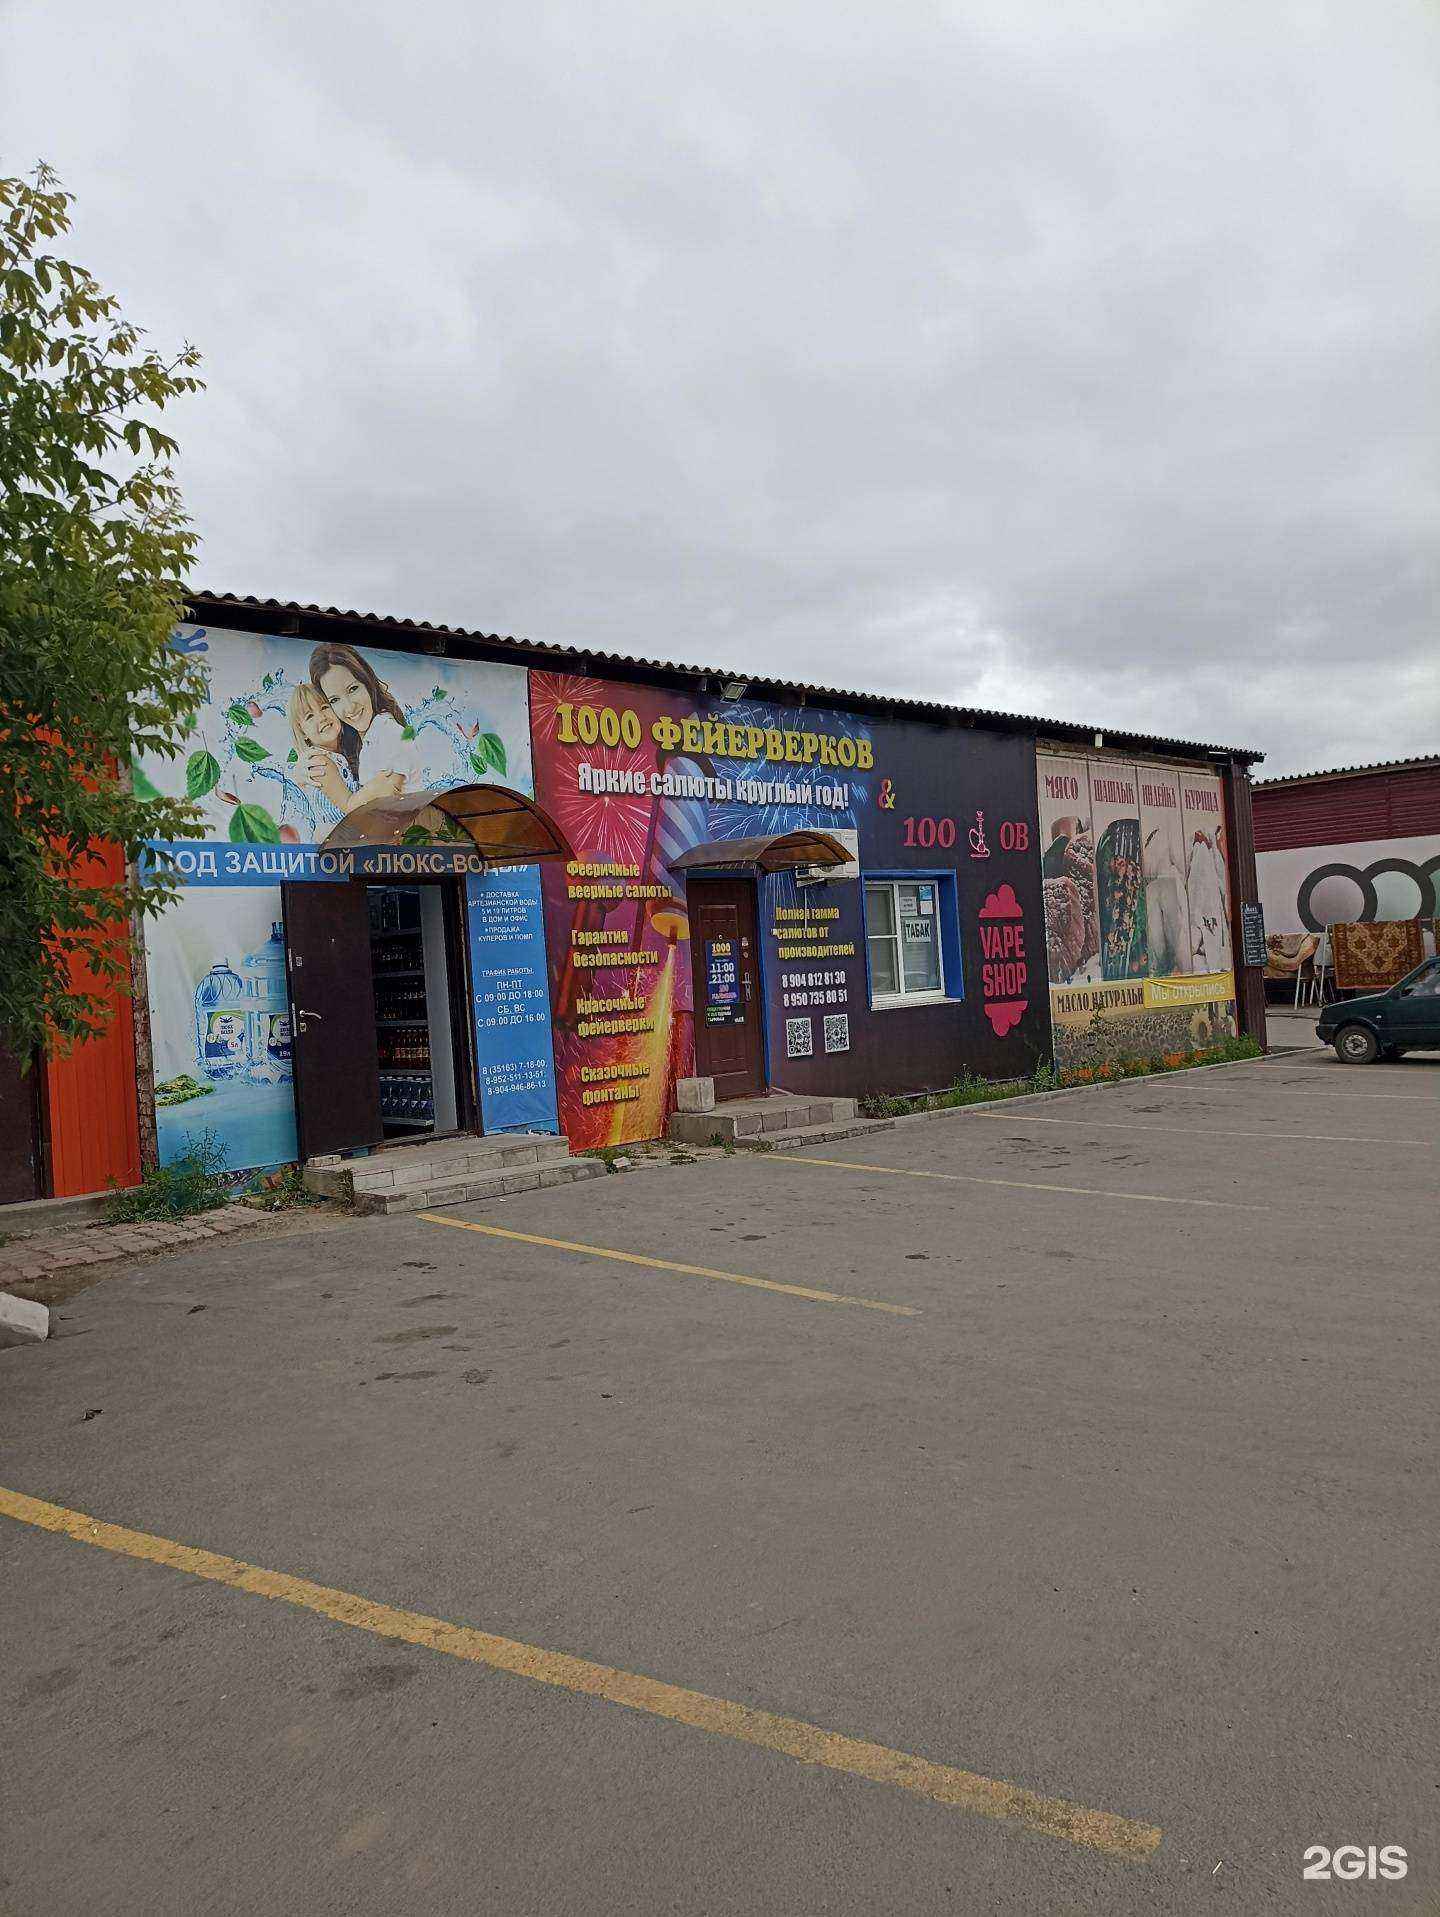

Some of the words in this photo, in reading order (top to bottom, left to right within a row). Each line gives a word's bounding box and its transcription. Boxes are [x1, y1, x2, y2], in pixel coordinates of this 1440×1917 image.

[556, 703, 642, 749] 1000
[651, 712, 875, 770] ФЕЙЕРВЕРКОВ
[577, 762, 647, 795] Яркие
[649, 771, 733, 800] салюты
[736, 778, 812, 806] круглый
[815, 783, 850, 811] год!
[877, 777, 896, 810] &
[1044, 775, 1079, 801] МЯСО
[1094, 779, 1136, 805] ШАШЛЫК
[1142, 783, 1177, 808] ИНДЕЙКА
[1184, 788, 1219, 812] КУРИЦА
[903, 816, 956, 848] 100
[1000, 821, 1029, 850] ОВ
[155, 850, 218, 878] ПОД
[225, 848, 354, 878] ЗАЩИТОЙ
[566, 860, 640, 877] Фееричные
[626, 885, 673, 898] салюты
[811, 907, 840, 920] гамма
[571, 929, 629, 946] Гарантия
[905, 923, 930, 938] ТАБАК
[778, 941, 855, 960] производителей
[979, 925, 1026, 959] VAPE
[573, 950, 659, 967] безопасности
[496, 980, 523, 989] ПН-ПТ
[782, 974, 788, 988] 8
[789, 973, 807, 987] 904
[808, 972, 823, 986] 812
[824, 971, 834, 985] 81
[834, 970, 846, 984] 30
[983, 962, 1027, 997] SHOP
[508, 991, 521, 1001] ДО
[576, 996, 646, 1015] Красочные
[783, 993, 790, 1007] 8
[790, 992, 808, 1006] 950
[809, 991, 825, 1005] 735
[826, 989, 838, 1004] 80
[838, 988, 848, 1003] 51
[1057, 992, 1089, 1013] МАСЛО
[510, 1014, 523, 1025] ДО
[578, 1016, 655, 1038] фейерверки
[580, 1062, 651, 1083] Сказочные
[582, 1085, 640, 1106] фонтаны
